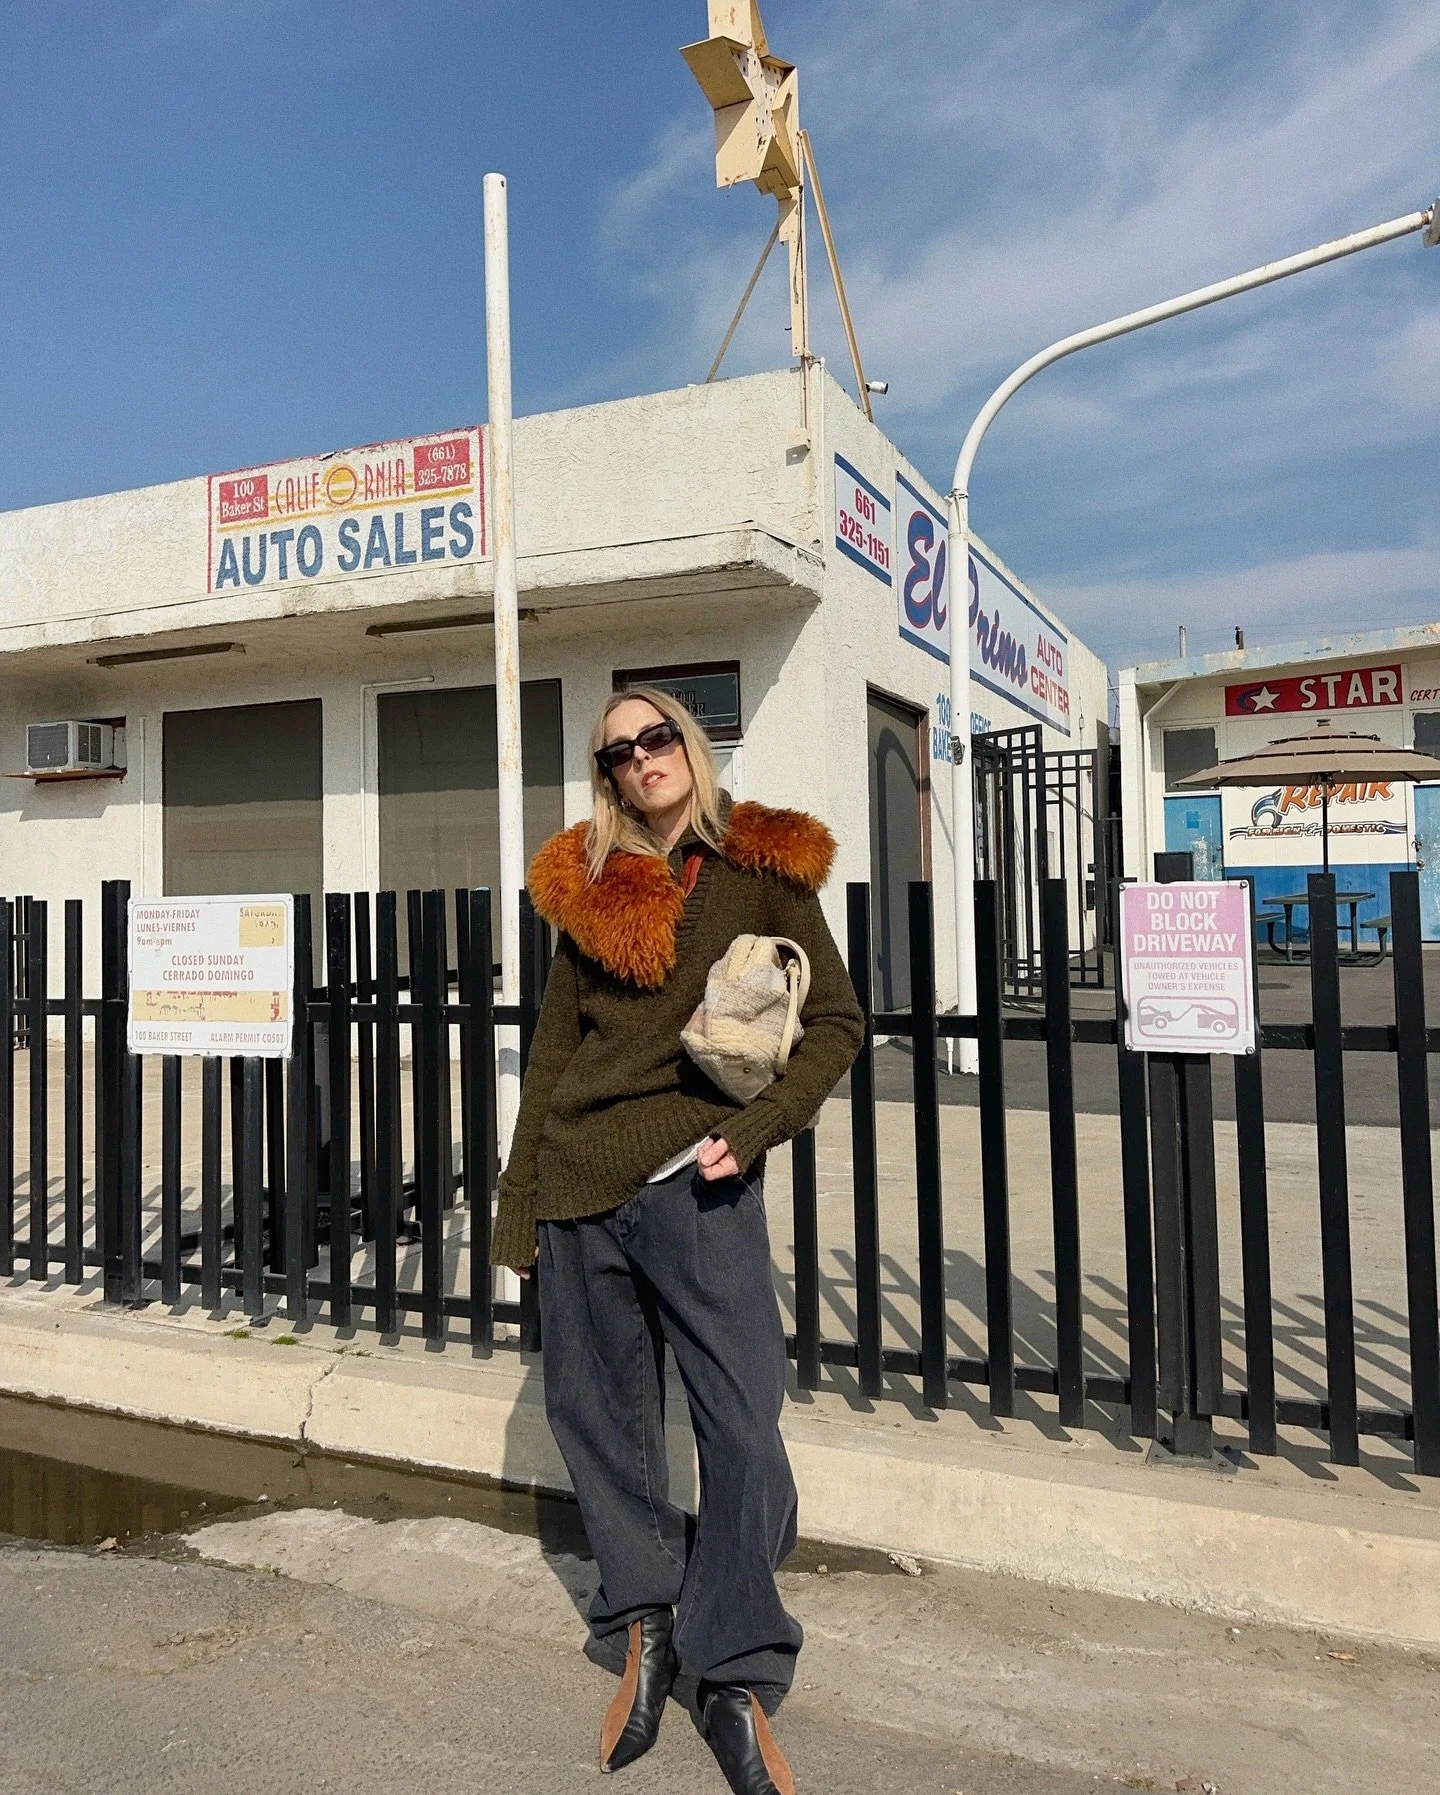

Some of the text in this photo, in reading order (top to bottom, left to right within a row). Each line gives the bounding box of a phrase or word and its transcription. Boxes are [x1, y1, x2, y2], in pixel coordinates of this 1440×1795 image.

[427, 445, 455, 462] (661)
[418, 462, 468, 487] 325-7878
[233, 481, 255, 498] 100
[222, 498, 266, 518] Baker St
[855, 487, 876, 526] 661
[216, 502, 474, 590] AUTO SALES
[839, 510, 890, 570] 325-1151
[904, 510, 947, 632] El
[1036, 634, 1063, 677] AUTO
[1030, 665, 1070, 717] CENTER
[1299, 669, 1399, 709] STAR
[1410, 688, 1440, 702] CERT
[932, 726, 953, 764] BAKE
[1279, 781, 1393, 814] REPAIR
[1247, 827, 1301, 837] FOREIGN
[1146, 891, 1220, 910] DO NOT
[136, 909, 201, 920] MONDAY-FRIDAY
[1151, 912, 1218, 931] BLOCK
[136, 922, 196, 933] LUNES-VIERNES
[1133, 933, 1237, 952] DRIVEWAY
[171, 954, 245, 967] CLOSED SUNDAY
[1134, 962, 1239, 971] UNAUTHORIZED VEHICLES
[162, 970, 255, 981] CERRADO DOMINGO
[1148, 972, 1226, 981] TOWED AT VEHICLE
[1148, 982, 1226, 991] OWNER'S EXPENSE
[135, 1031, 193, 1042] 100 BAKER STREET
[210, 1032, 235, 1043] ALARM
[235, 1033, 261, 1043] PERMIT
